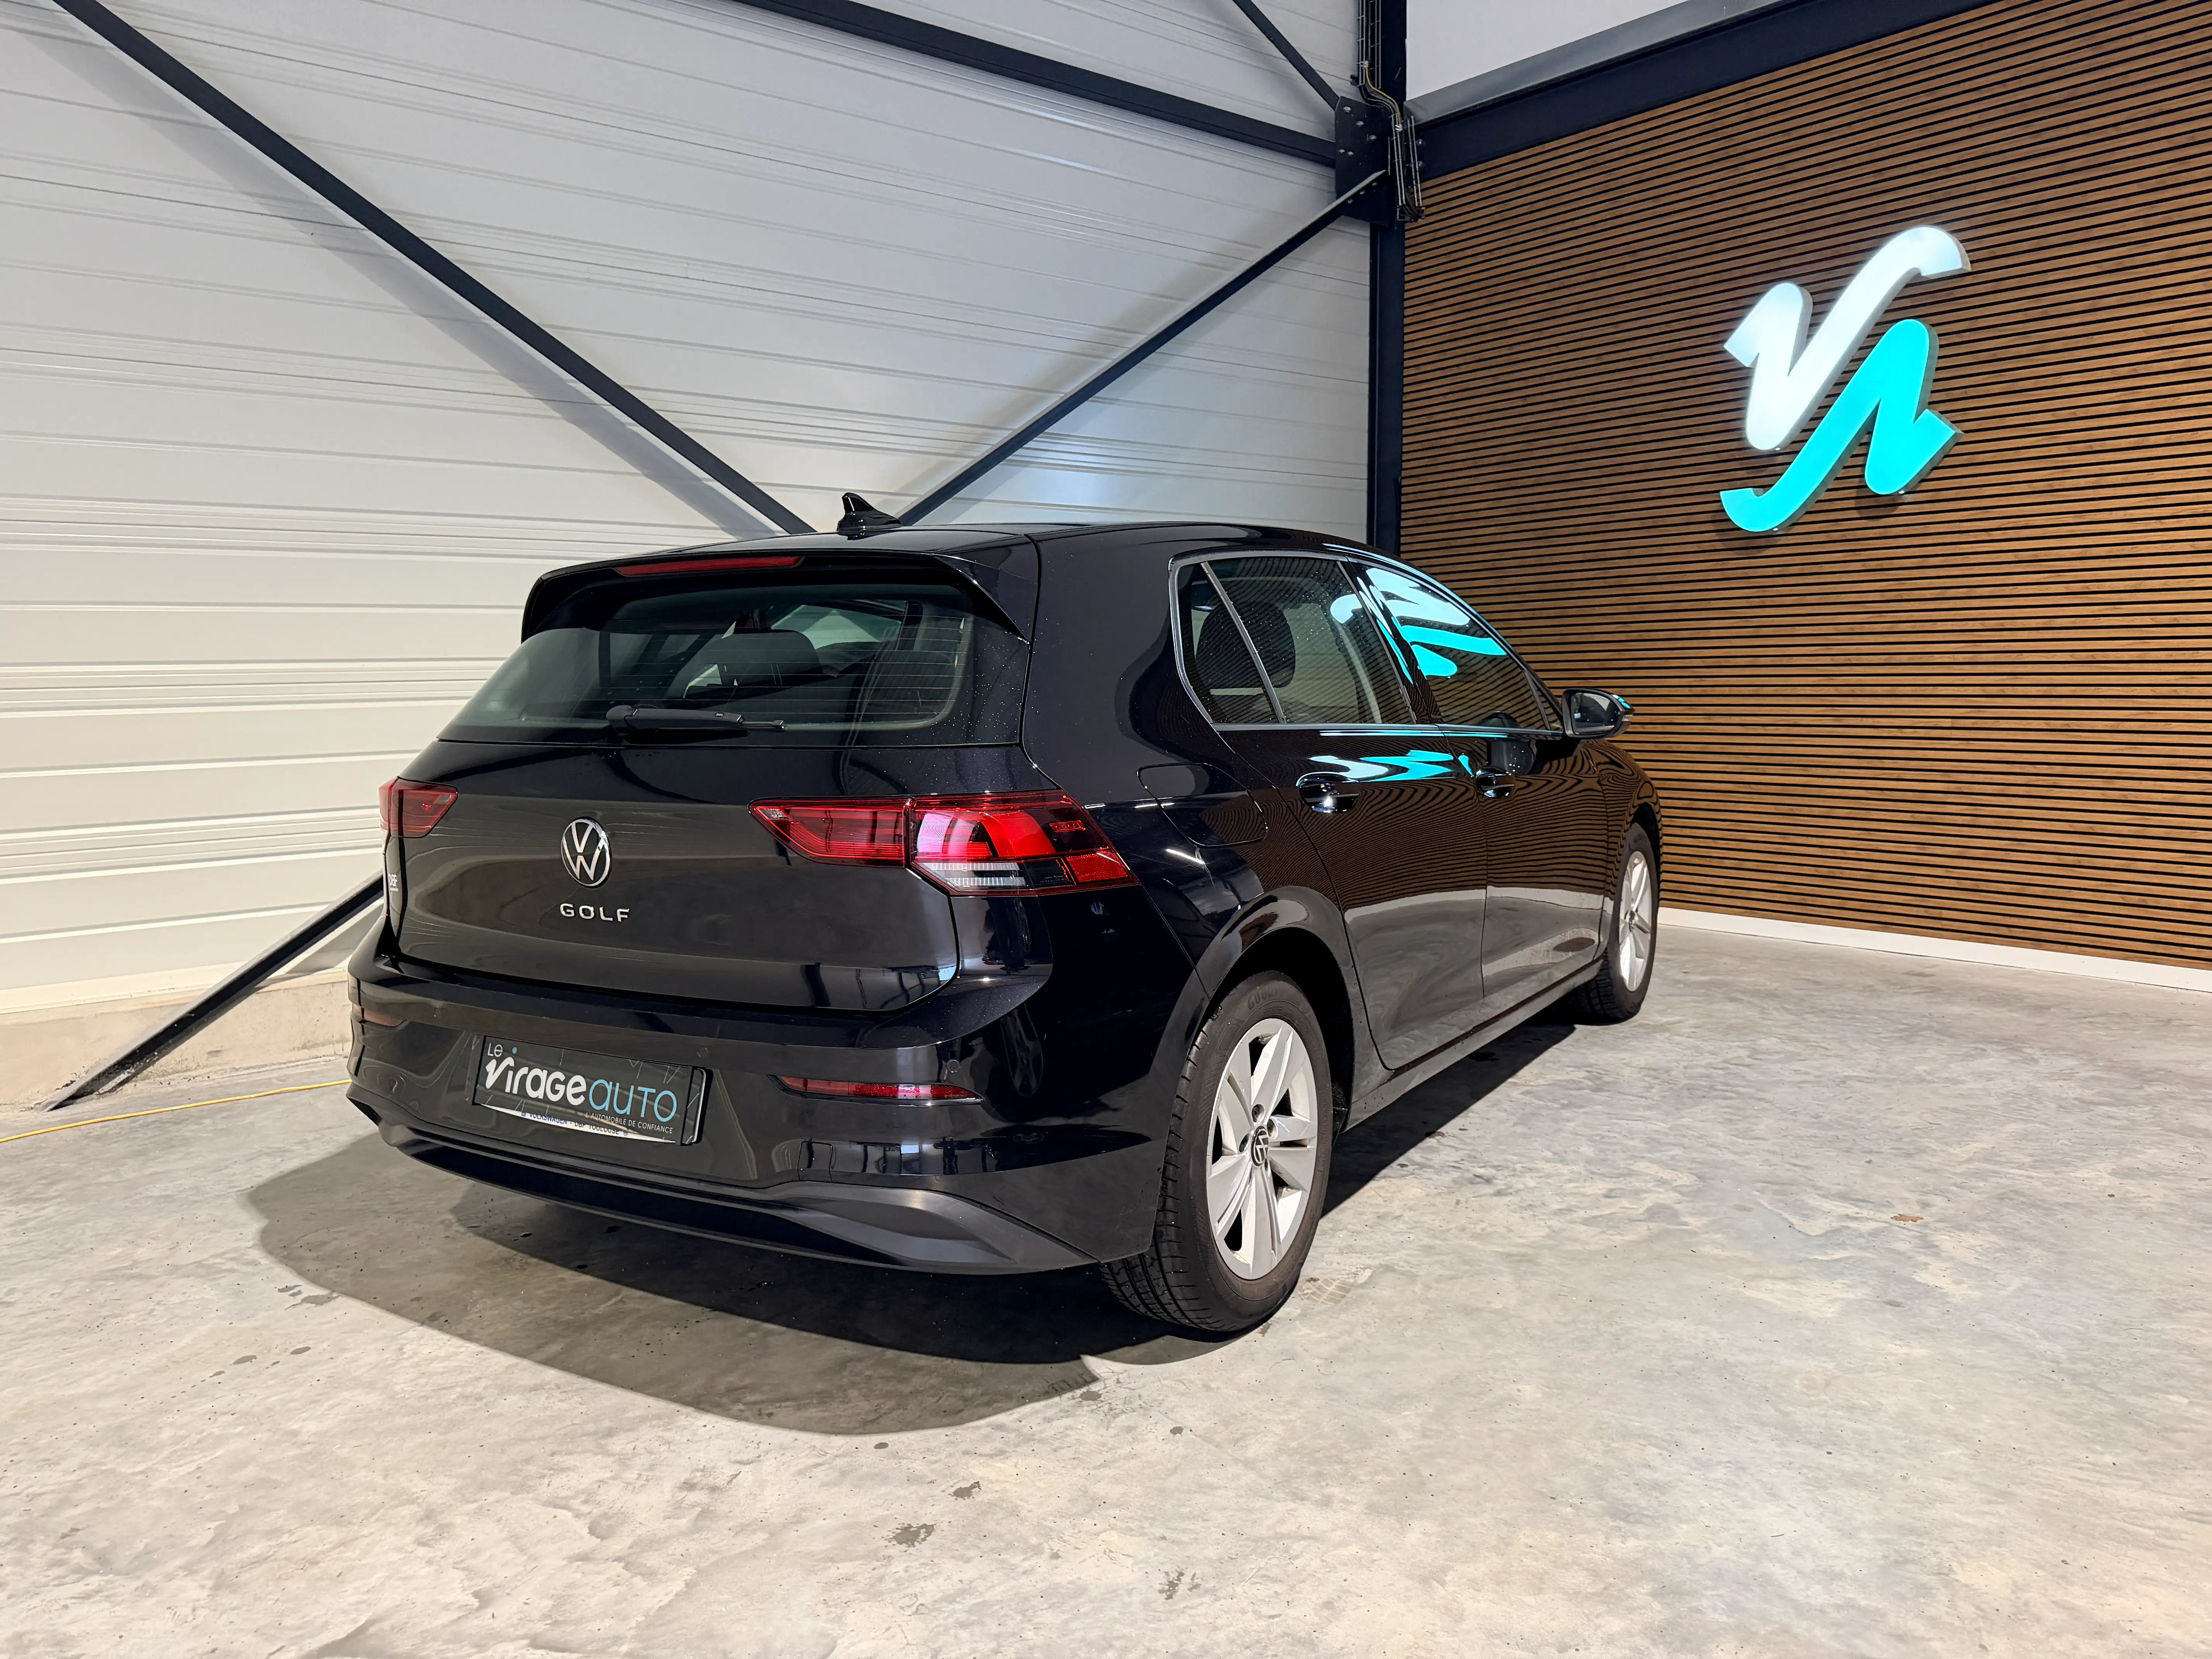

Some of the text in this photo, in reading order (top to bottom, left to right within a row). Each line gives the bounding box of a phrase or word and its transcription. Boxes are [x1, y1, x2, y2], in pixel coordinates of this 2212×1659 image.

[560, 903, 629, 922] GOLF
[488, 1043, 503, 1057] Le
[586, 1112, 627, 1125] L'AUTOMOBILE
[637, 1121, 673, 1134] CONFIANCE
